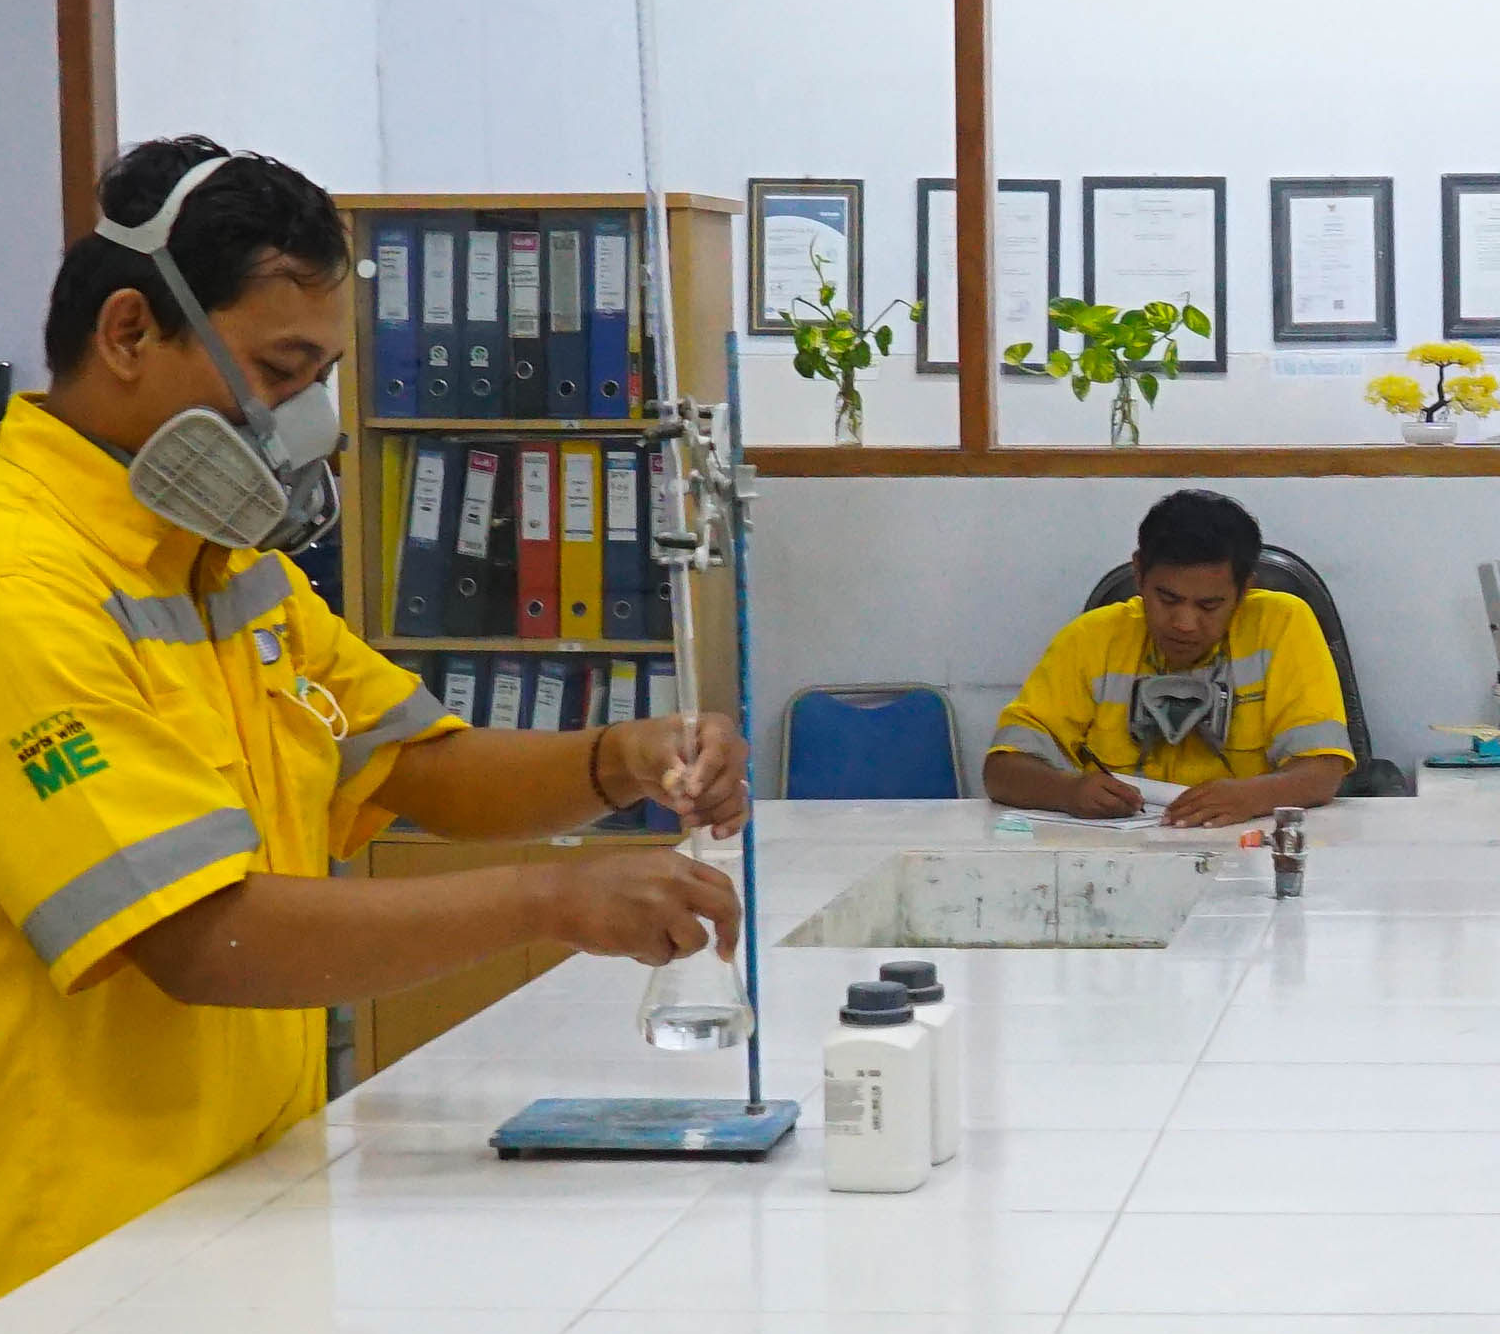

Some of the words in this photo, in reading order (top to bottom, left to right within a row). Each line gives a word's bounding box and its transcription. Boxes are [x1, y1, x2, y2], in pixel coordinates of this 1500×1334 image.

[17, 735, 54, 763] starts
[56, 720, 86, 740] with
[23, 731, 111, 802] ME
